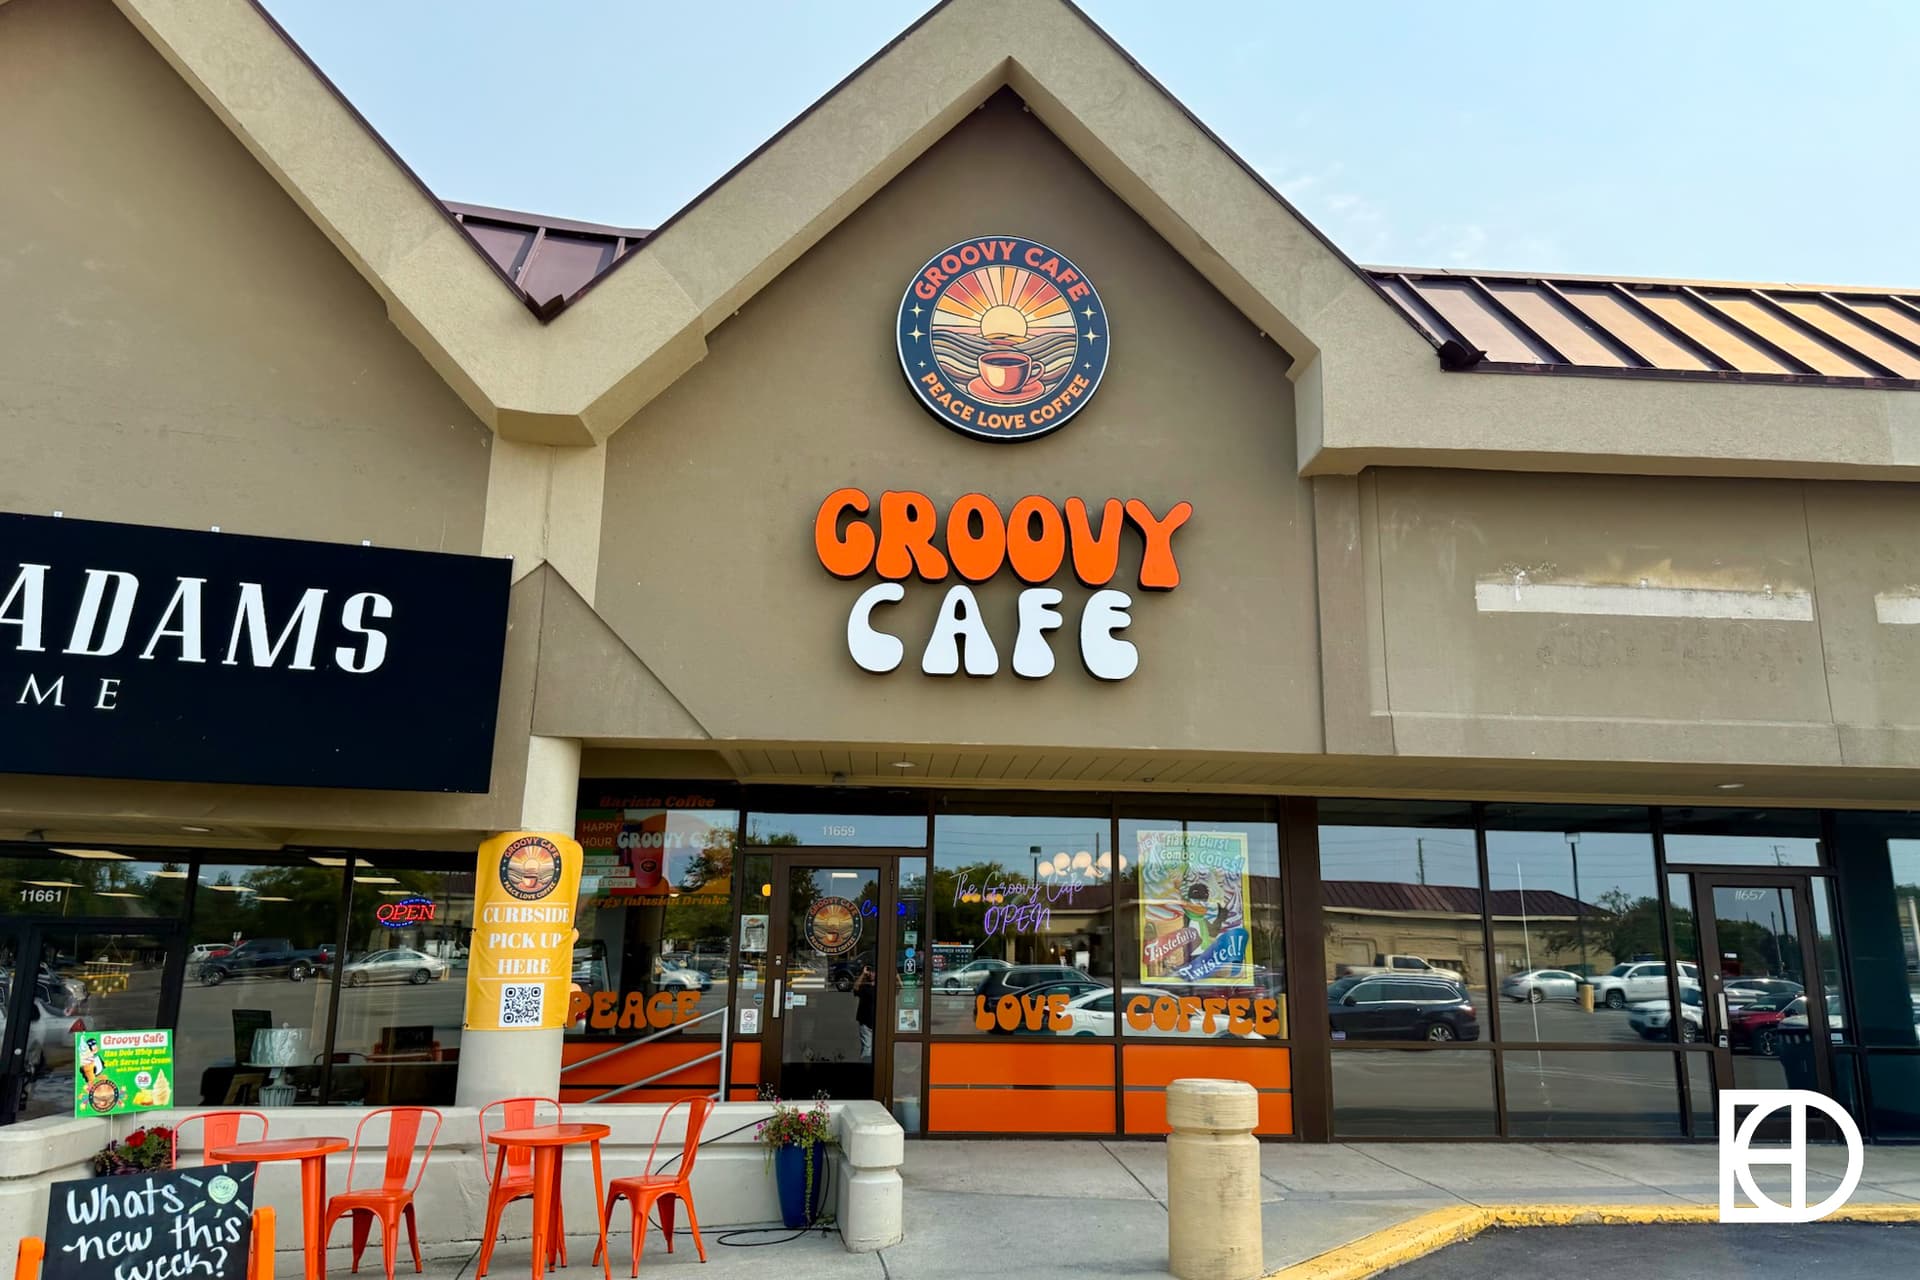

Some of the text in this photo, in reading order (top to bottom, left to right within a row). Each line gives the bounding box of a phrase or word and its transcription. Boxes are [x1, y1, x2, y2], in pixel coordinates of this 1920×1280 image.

[915, 241, 1090, 302] GROOVY CAFE
[921, 372, 1090, 430] PEACE LOVE COFFEE
[815, 488, 1193, 589] GROOVY
[847, 582, 1139, 680] CAFE
[582, 837, 612, 847] HOUR
[583, 823, 619, 833] HAPPY
[617, 832, 685, 849] GROOVY
[823, 826, 856, 837] 11659
[20, 889, 62, 903] 11661
[950, 868, 977, 907] The
[1735, 890, 1767, 901] 11657
[376, 903, 437, 921] OPEN
[482, 906, 570, 924] CURBSIDE
[984, 903, 1051, 935] OPEN
[489, 932, 563, 949] PICK UP
[1144, 928, 1198, 962] Tastefully
[497, 957, 551, 975] HERE
[1180, 935, 1244, 981] Twisted!
[566, 990, 701, 1030] PEACE
[975, 993, 1074, 1032] LOVE
[1126, 994, 1280, 1035] COFFEE
[103, 1033, 164, 1046] Groovy Cafe
[66, 1178, 184, 1225] Whats
[62, 1213, 242, 1263] new this
[114, 1246, 229, 1280] week?
